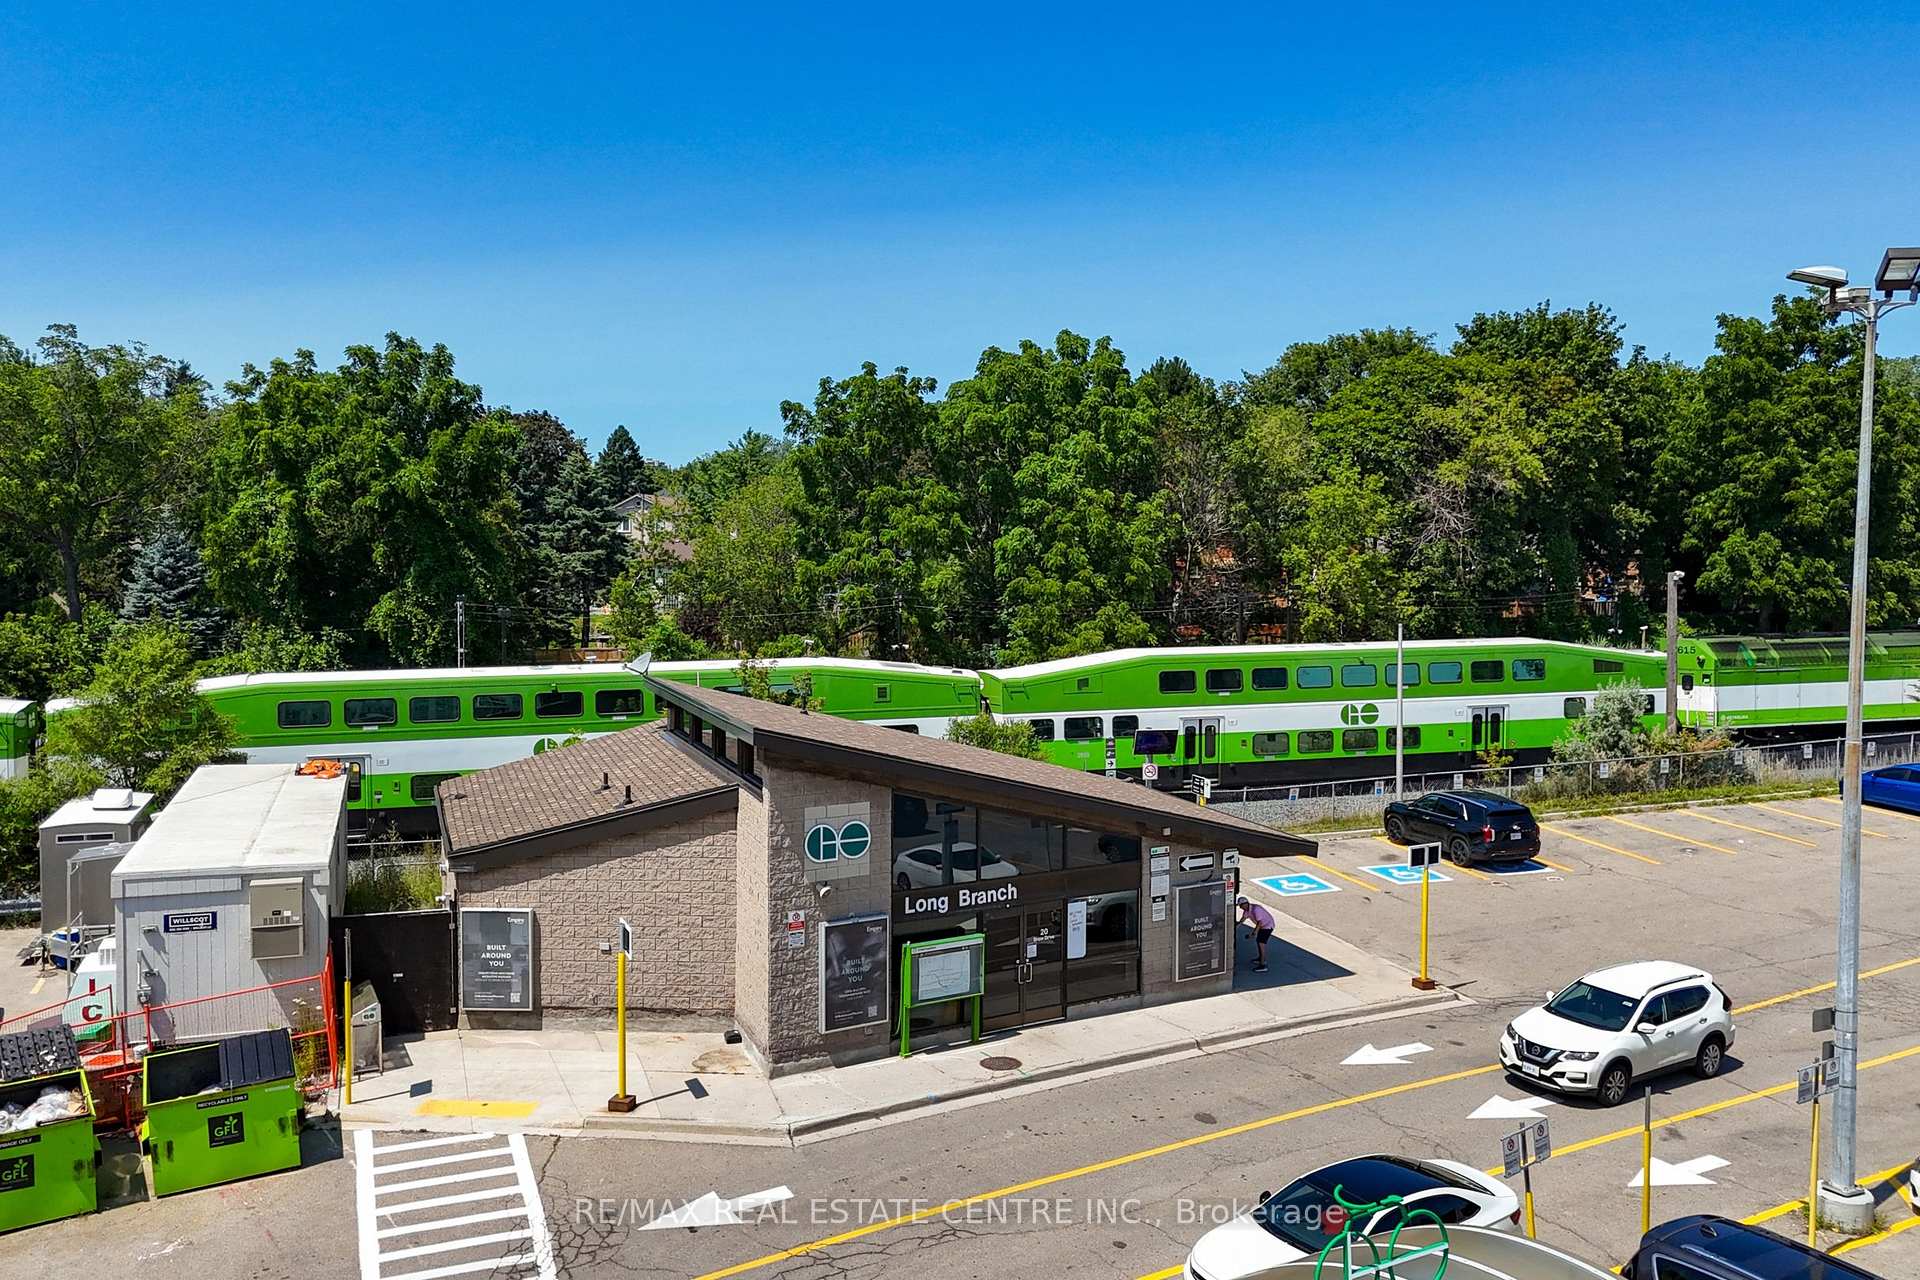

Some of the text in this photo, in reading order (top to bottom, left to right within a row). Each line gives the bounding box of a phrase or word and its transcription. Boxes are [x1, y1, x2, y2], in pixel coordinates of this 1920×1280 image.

[1677, 646, 1696, 655] 615
[905, 883, 1018, 914] Long Branch
[172, 916, 209, 925] WILLSCOT
[846, 958, 865, 967] BUILT
[841, 963, 872, 976] AROUND
[848, 975, 863, 983] YOU
[214, 1117, 239, 1137] GFL
[1, 1161, 28, 1181] GFL
